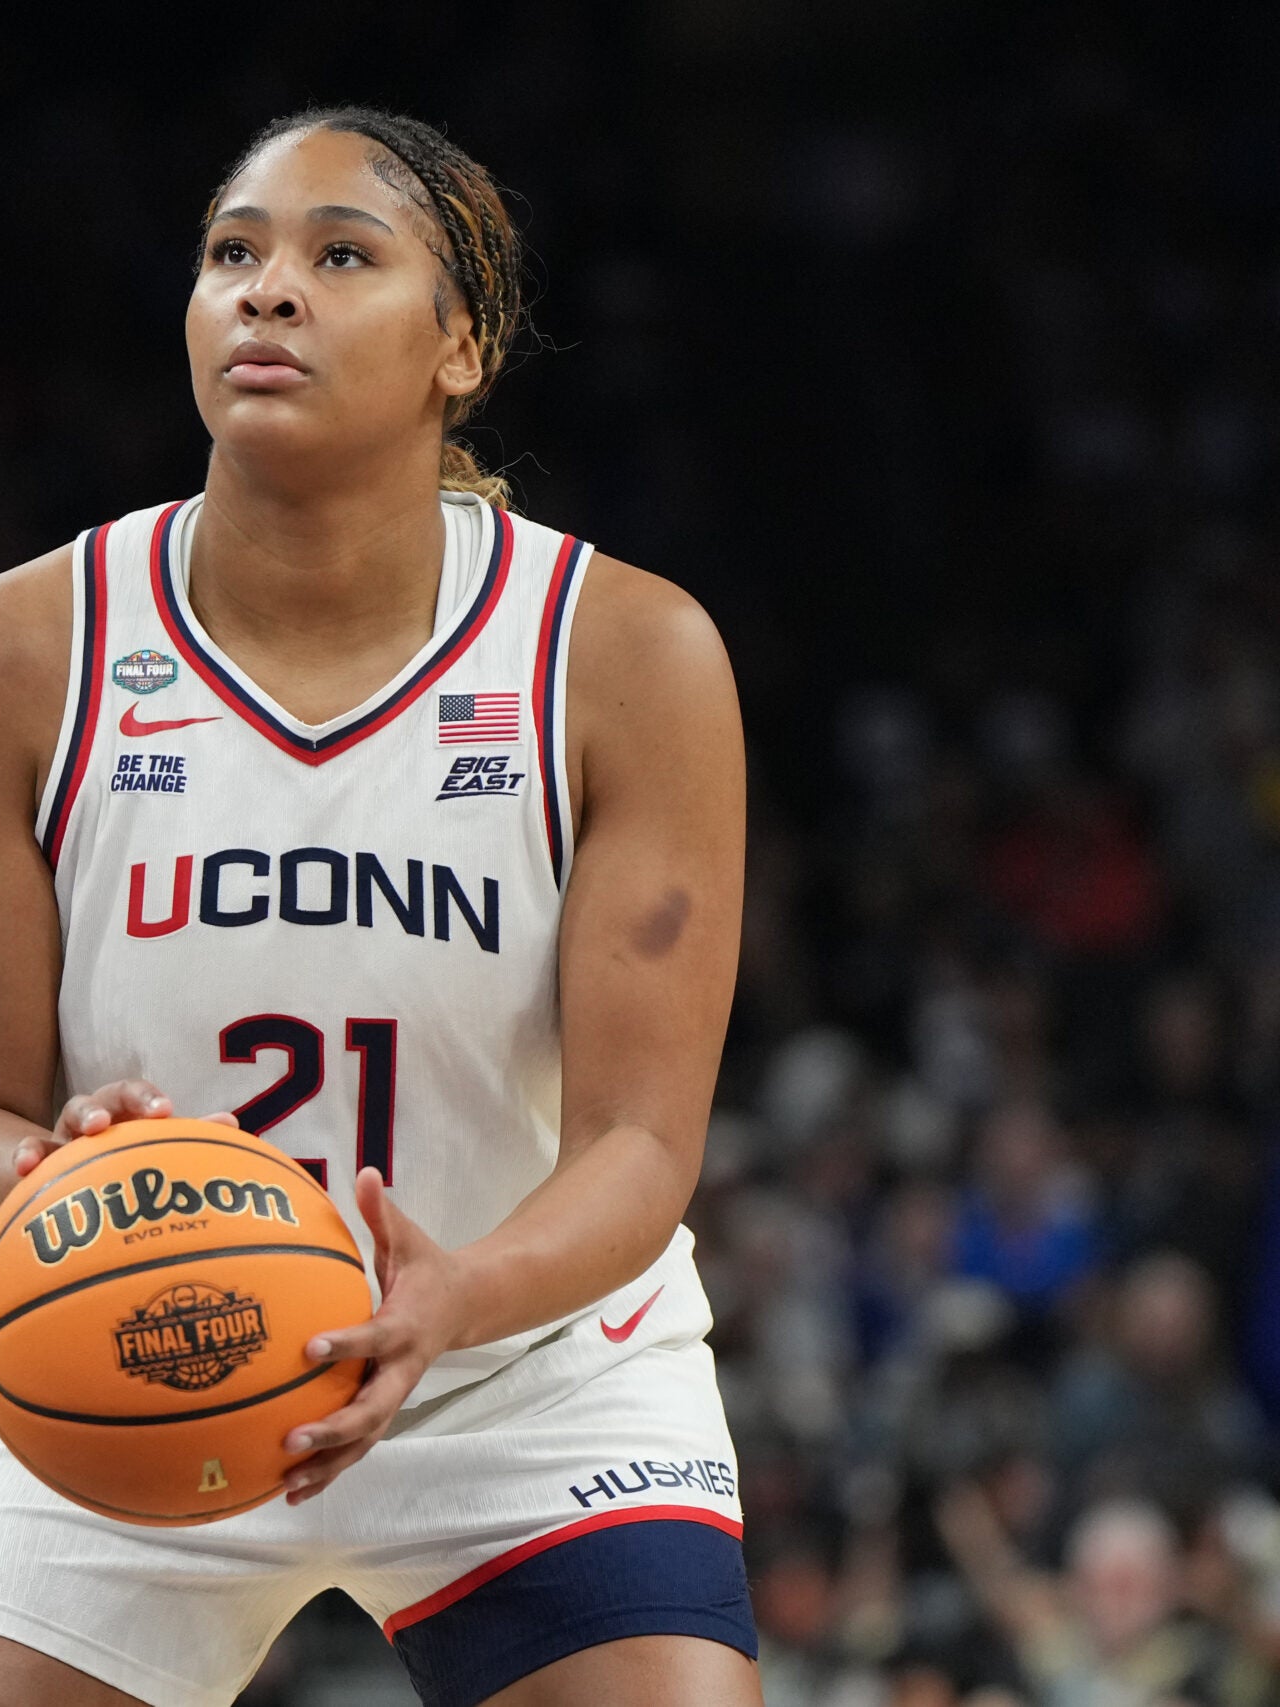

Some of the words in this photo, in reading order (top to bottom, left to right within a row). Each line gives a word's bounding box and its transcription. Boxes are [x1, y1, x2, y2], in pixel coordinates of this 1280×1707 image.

[116, 664, 145, 678] FINAL
[146, 664, 173, 677] FOUR
[117, 754, 143, 773] BE
[149, 754, 186, 774] THE
[449, 756, 511, 774] BIG
[111, 773, 187, 793] CHANGE
[440, 773, 526, 792] EAST
[126, 847, 499, 954] UCONN
[219, 1013, 398, 1191] 21
[23, 1167, 299, 1267] Wilson
[123, 1226, 163, 1245] EVO
[169, 1219, 210, 1233] NXT
[121, 1324, 192, 1360] FINAL
[195, 1308, 261, 1347] FOUR
[569, 1459, 735, 1508] HUSKIES
